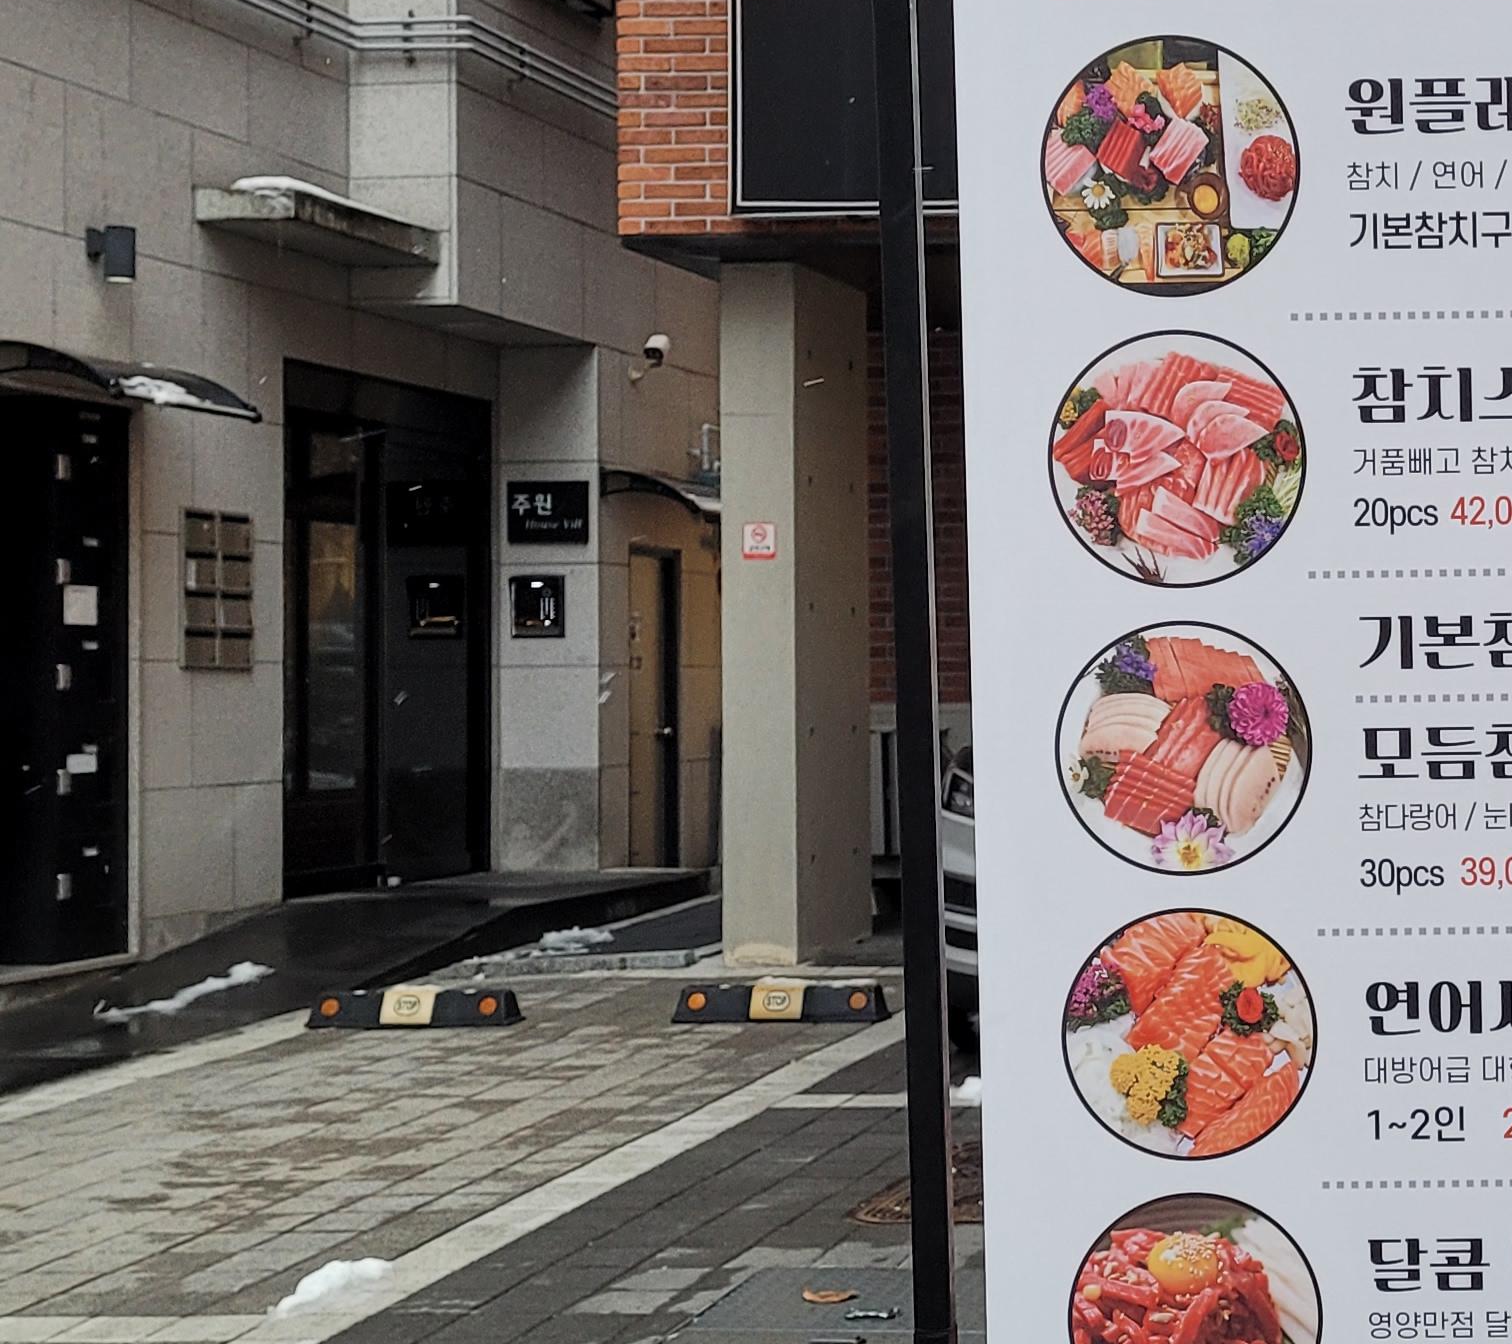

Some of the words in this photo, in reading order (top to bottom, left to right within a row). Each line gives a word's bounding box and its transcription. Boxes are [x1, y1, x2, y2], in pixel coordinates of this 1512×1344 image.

[1347, 161, 1398, 190] 참치
[1433, 161, 1483, 189] 연어
[1354, 448, 1460, 475] 거품빼고
[512, 493, 552, 515] 주원
[1354, 498, 1438, 535] 20pcs
[1360, 803, 1456, 831] 참다랑어
[1360, 859, 1444, 895] 30pcs
[1365, 1056, 1470, 1084] 대방어급
[1368, 1106, 1465, 1141] 1~2인
[1368, 1238, 1490, 1292] 달콤
[1369, 1312, 1473, 1339] 영양만점
